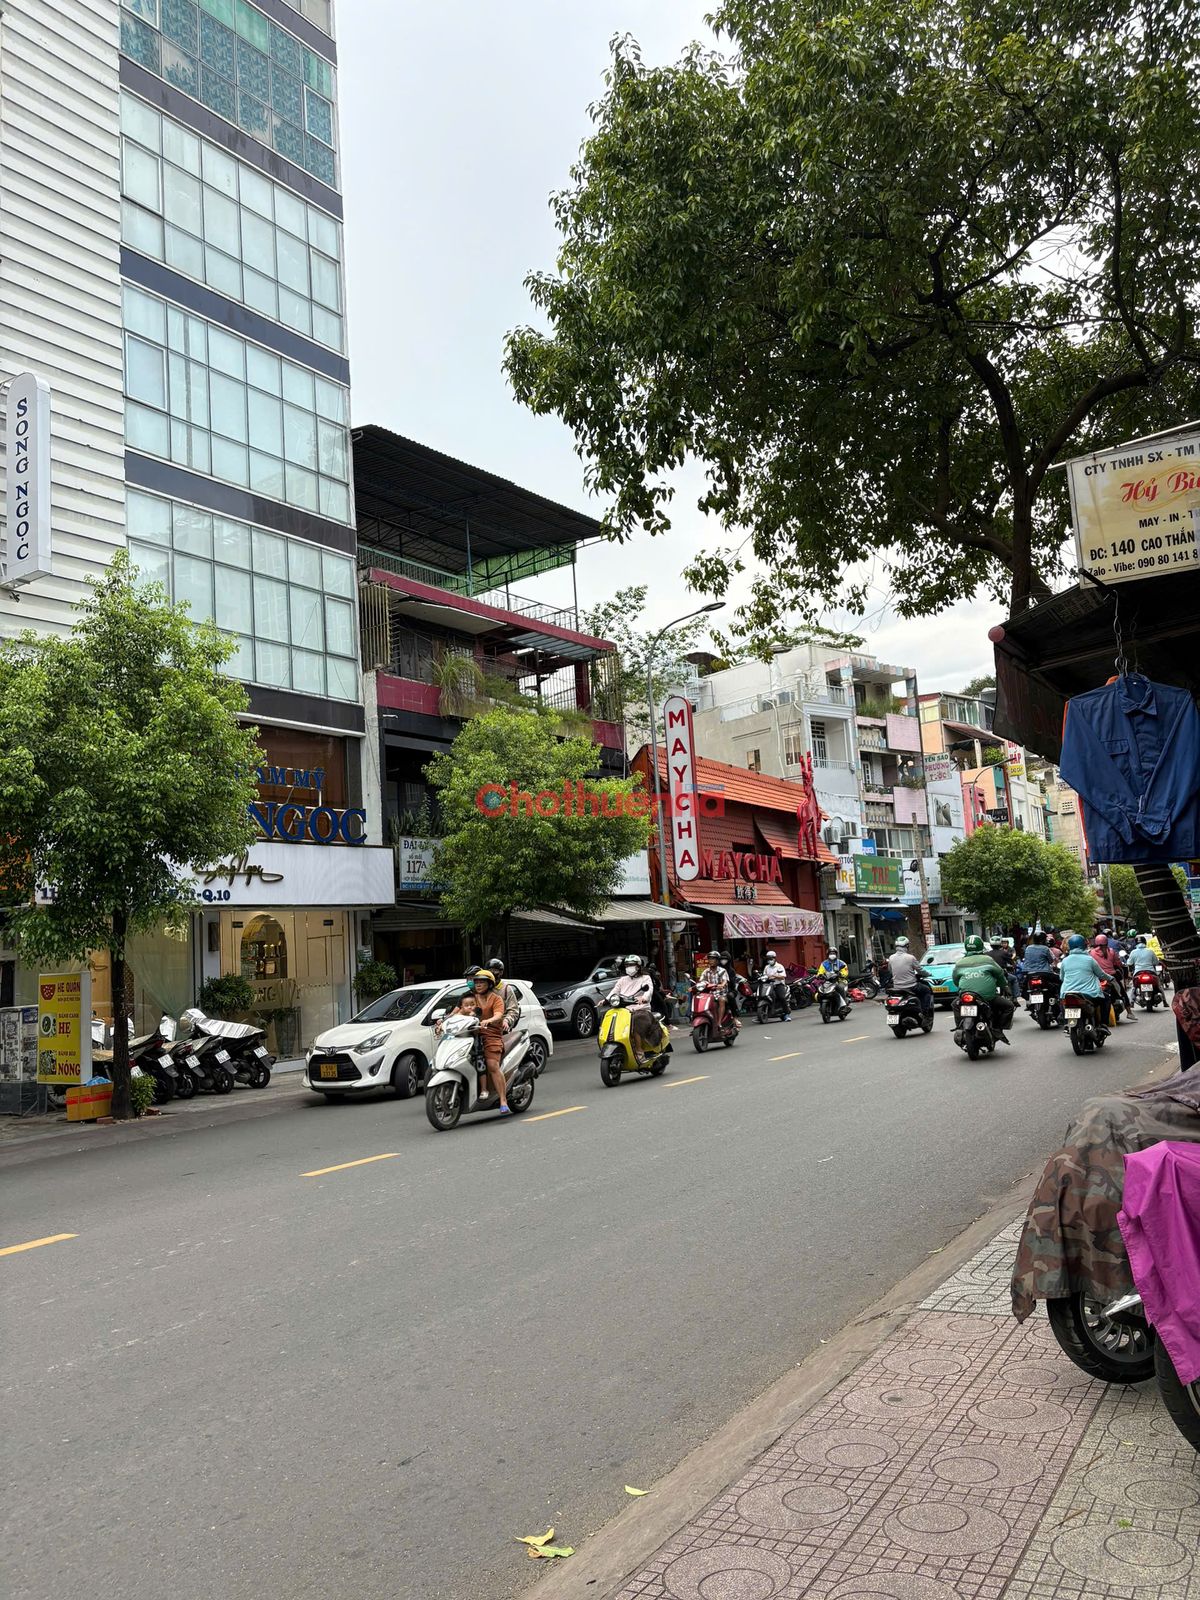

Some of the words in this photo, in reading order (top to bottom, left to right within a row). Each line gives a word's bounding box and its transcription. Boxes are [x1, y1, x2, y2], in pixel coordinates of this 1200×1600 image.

[16, 397, 29, 474] SONG
[1084, 463, 1107, 476] CTY
[1110, 455, 1144, 470] TNHH
[1148, 451, 1164, 463] SX
[1175, 445, 1194, 457] TM
[16, 481, 29, 560] NGỌC
[1139, 516, 1160, 528] MAY
[1169, 513, 1180, 523] IN
[1090, 548, 1107, 561] ĐC:
[1111, 539, 1136, 557] 140
[1141, 536, 1163, 551] CAO
[1165, 526, 1195, 547] THẮN
[1114, 562, 1136, 574] Vibe:
[1137, 557, 1155, 569] 090
[1157, 554, 1169, 564] 80
[1173, 551, 1190, 562] 141
[668, 708, 696, 868] MAYCHA
[700, 849, 783, 882] MAYCHA
[58, 1021, 71, 1038] HẸ
[58, 1060, 81, 1076] NÓNG
